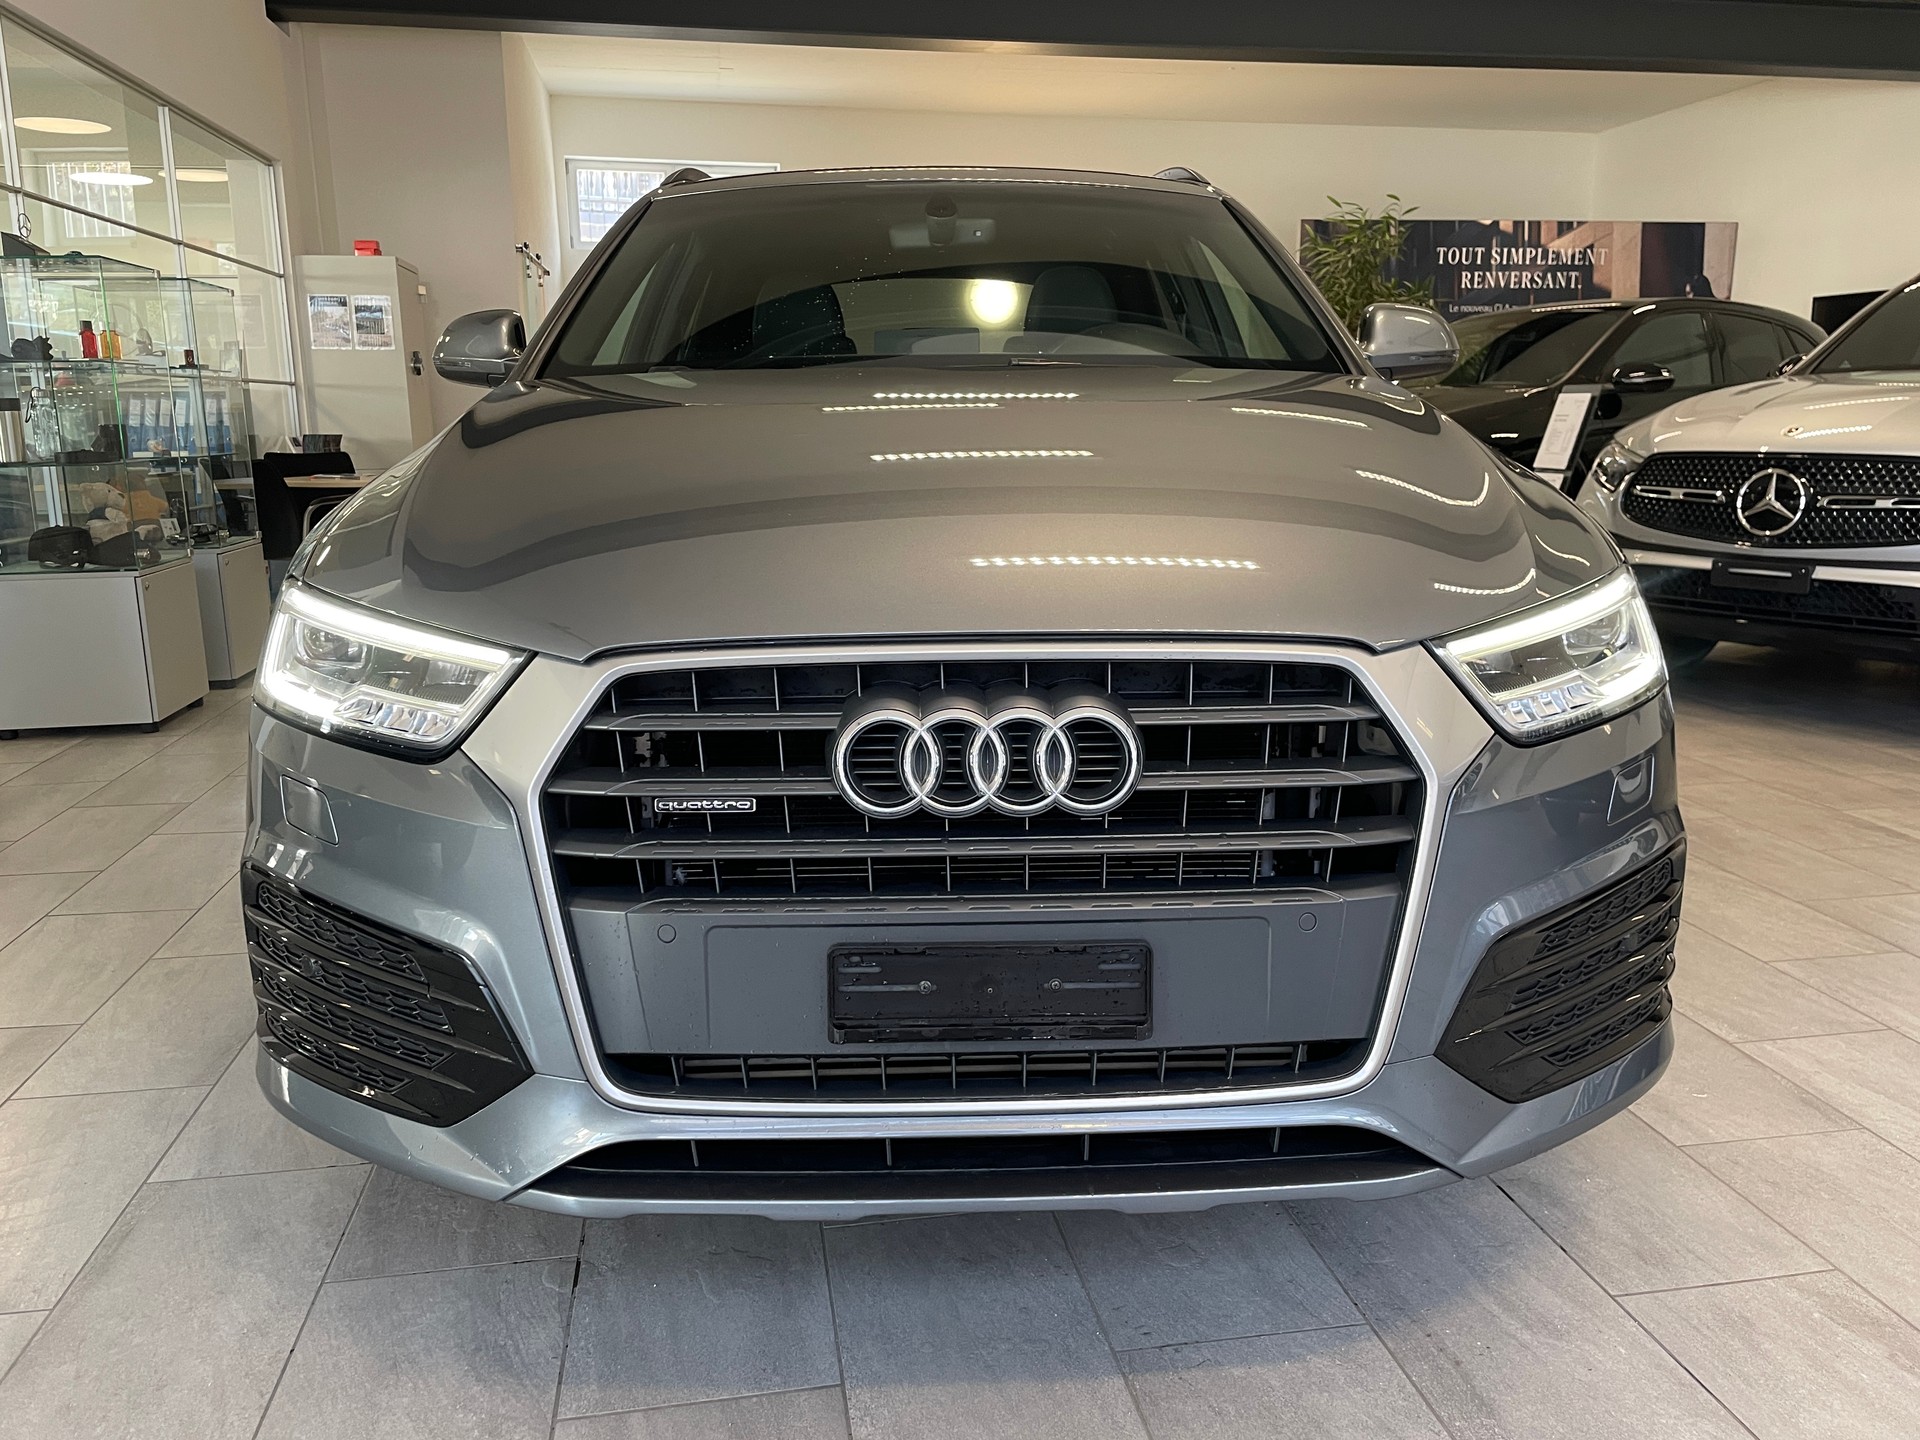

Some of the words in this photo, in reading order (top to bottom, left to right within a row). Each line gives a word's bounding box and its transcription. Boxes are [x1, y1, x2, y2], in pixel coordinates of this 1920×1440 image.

[1436, 247, 1486, 265] TOUT
[1490, 247, 1609, 266] SIMPLEMENT
[1460, 271, 1583, 289] RENVERSANT.
[1449, 303, 1459, 313] Le
[1460, 304, 1493, 313] nouveau
[658, 800, 751, 811] quattro
